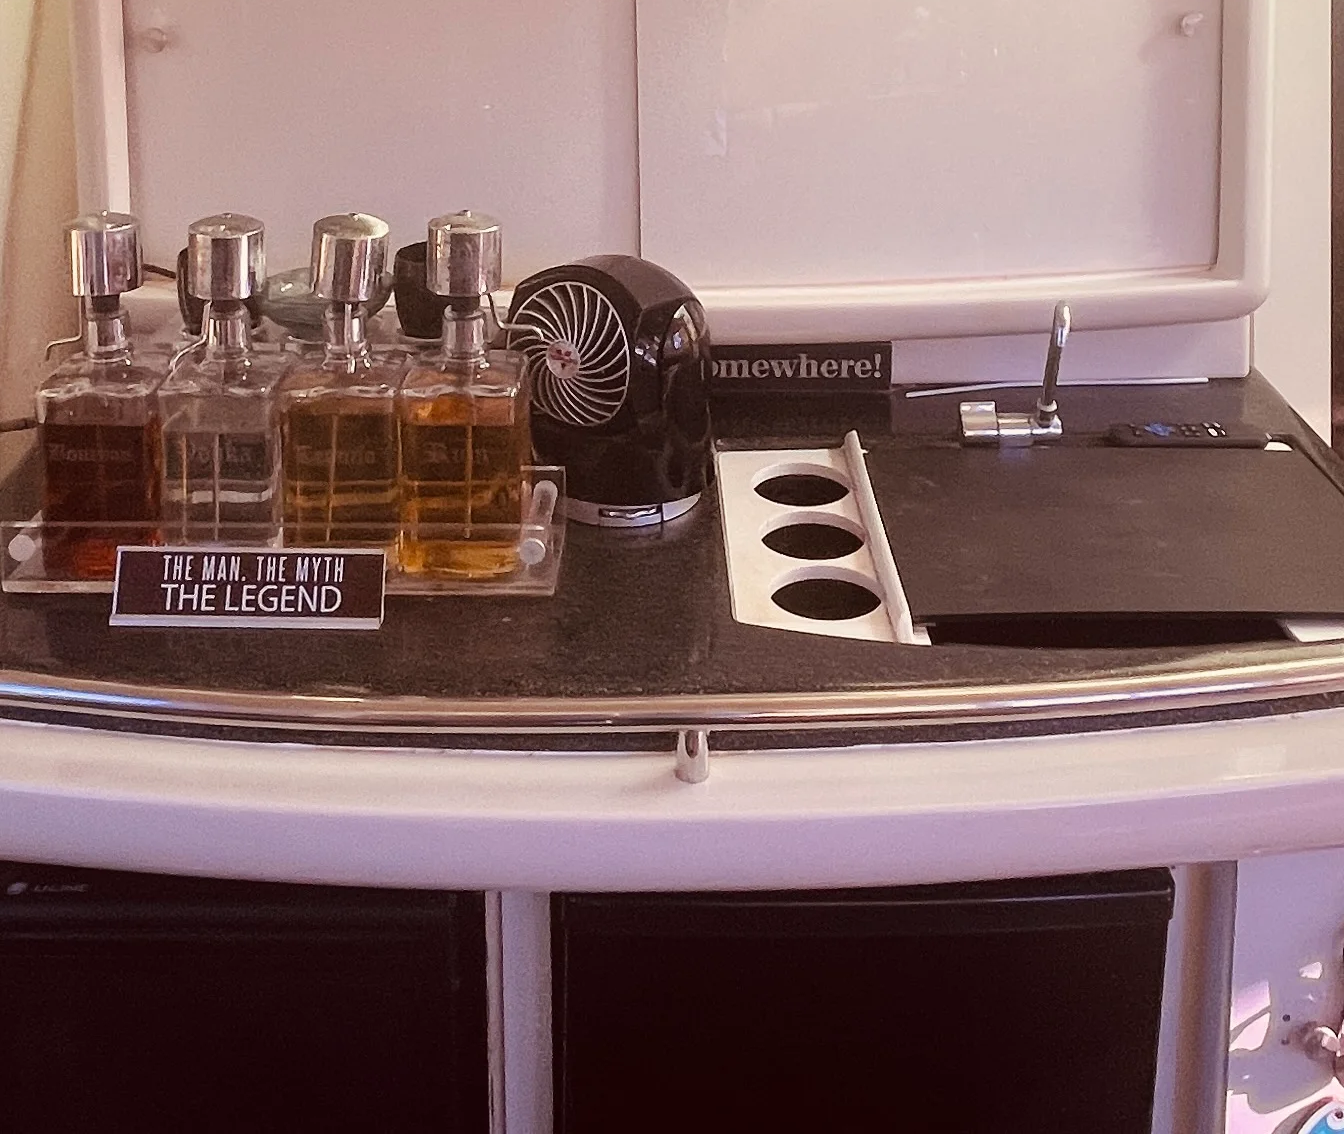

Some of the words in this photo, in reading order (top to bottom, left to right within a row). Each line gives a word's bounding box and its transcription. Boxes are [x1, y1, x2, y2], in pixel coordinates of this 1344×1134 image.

[163, 554, 194, 581] THE
[256, 556, 288, 582] THE
[296, 556, 345, 583] MYTH
[160, 583, 217, 611] THE
[224, 584, 343, 613] LEGEND
